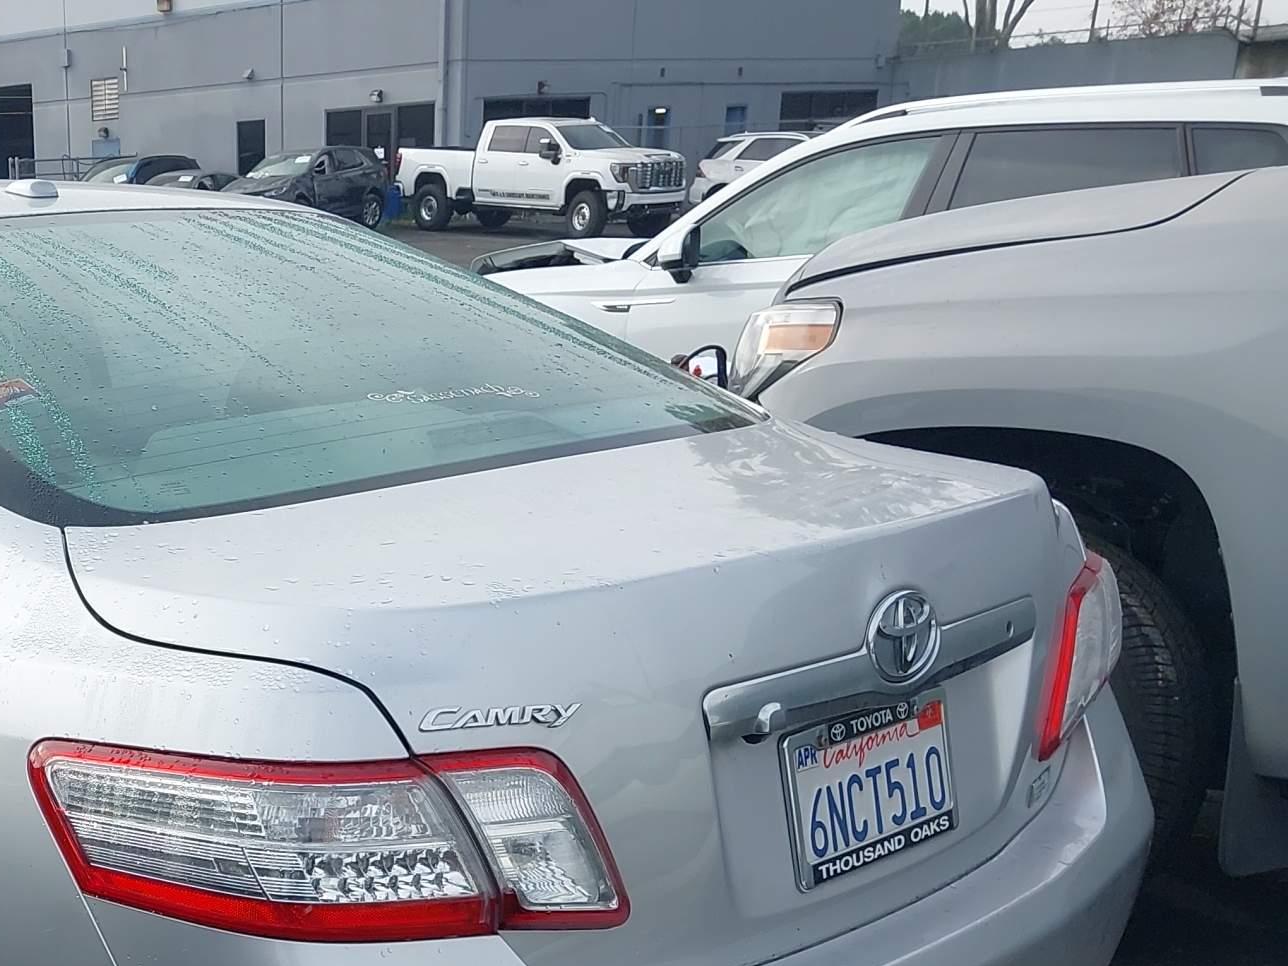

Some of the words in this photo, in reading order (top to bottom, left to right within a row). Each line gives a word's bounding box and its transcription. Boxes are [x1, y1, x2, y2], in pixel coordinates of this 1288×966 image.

[418, 703, 583, 732] CAMRY
[850, 708, 894, 734] TOYOTA
[797, 745, 818, 769] APR
[811, 746, 946, 858] 6NCT510
[818, 834, 905, 880] THOUSAND
[911, 815, 950, 843] OAKS
